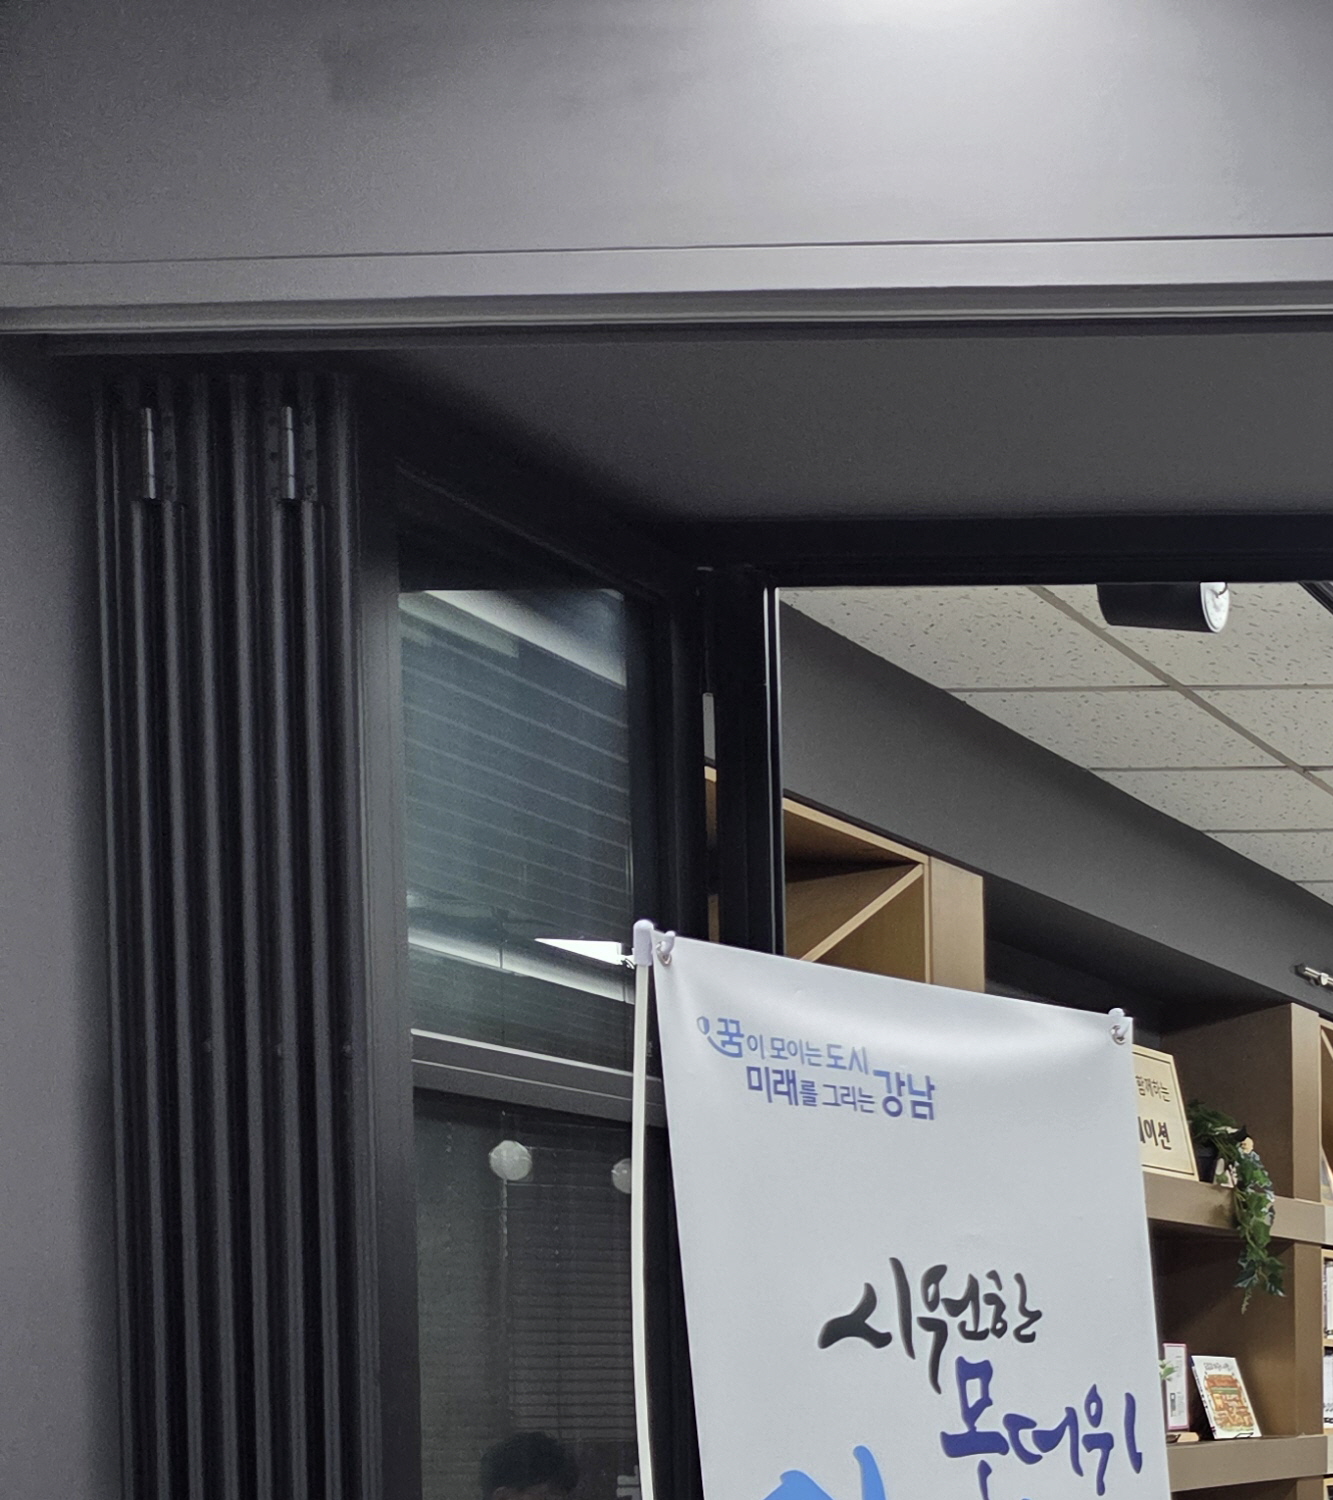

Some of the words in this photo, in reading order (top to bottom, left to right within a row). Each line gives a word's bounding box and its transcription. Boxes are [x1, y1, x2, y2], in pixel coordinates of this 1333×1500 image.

[706, 1016, 766, 1060] 꿈이
[770, 1036, 823, 1068] 모이는
[825, 1042, 869, 1075] 도시
[746, 1065, 818, 1107] 미래를
[821, 1083, 875, 1114] 그리는
[872, 1069, 936, 1121] 강남
[818, 1256, 1044, 1395] 시원한
